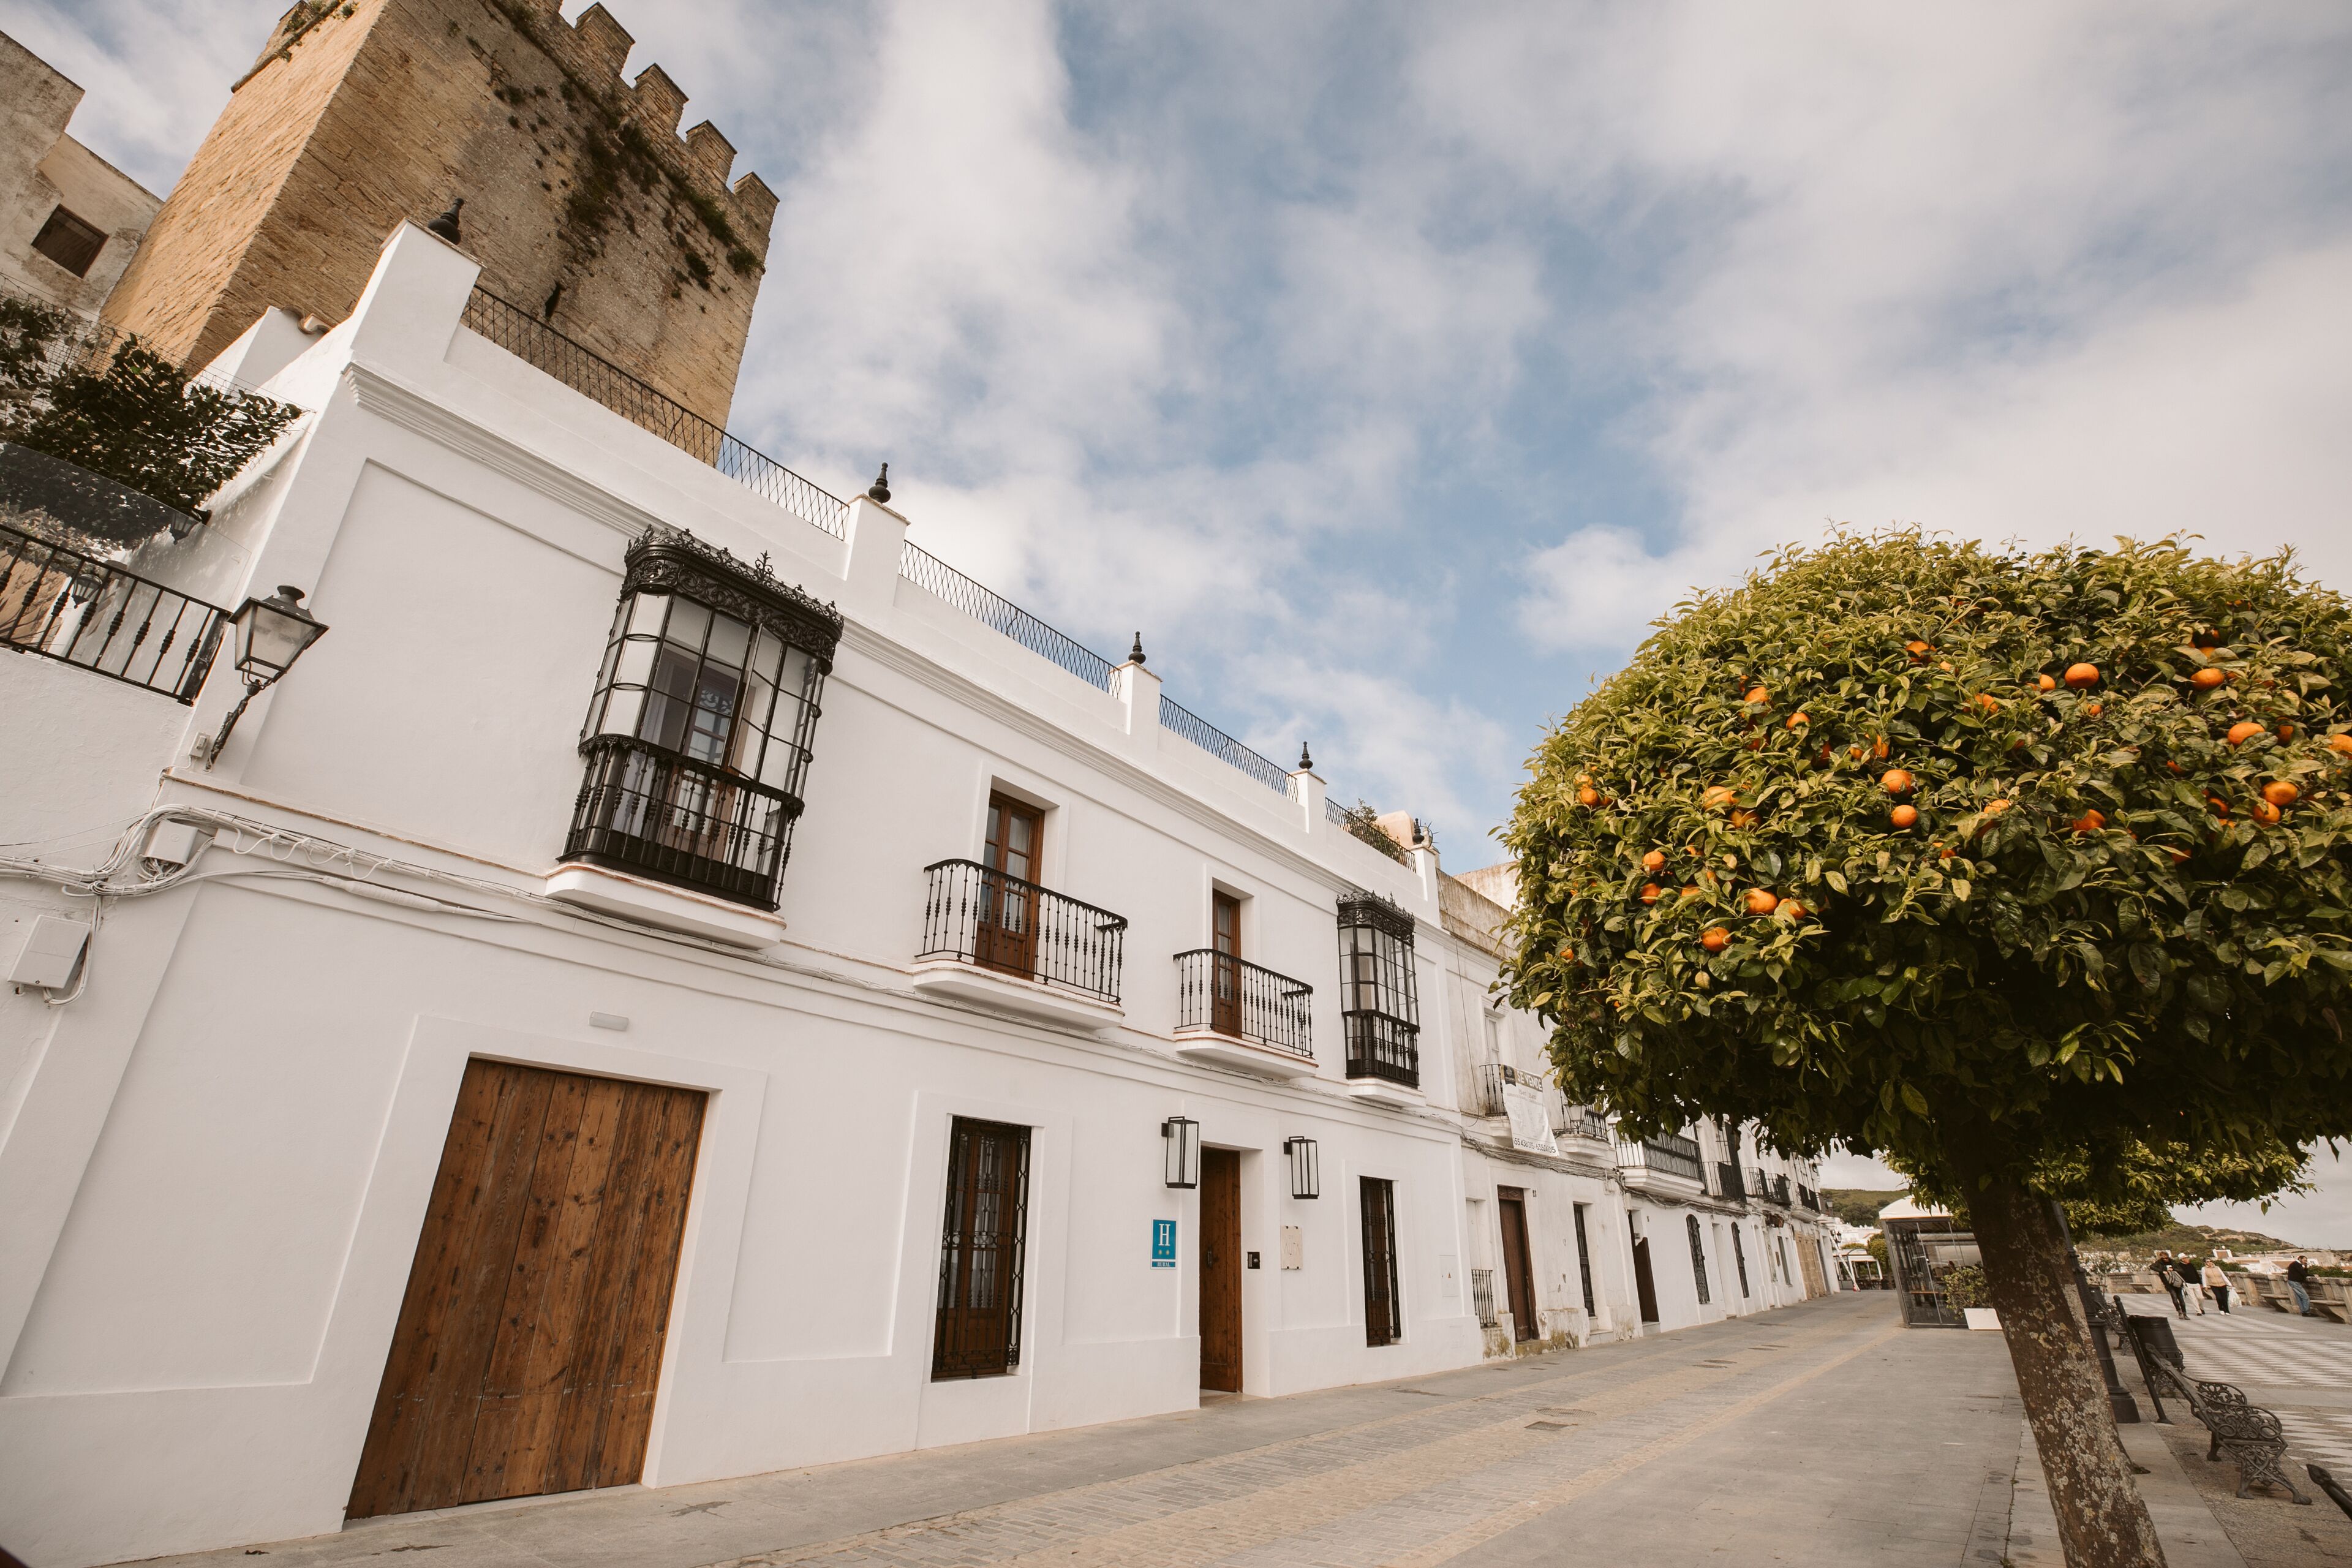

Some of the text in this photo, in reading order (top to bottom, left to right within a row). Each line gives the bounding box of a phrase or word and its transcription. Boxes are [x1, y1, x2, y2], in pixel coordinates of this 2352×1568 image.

[1517, 1070, 1525, 1084] SE
[1525, 1073, 1542, 1090] VENDE
[1158, 1224, 1170, 1246] H
